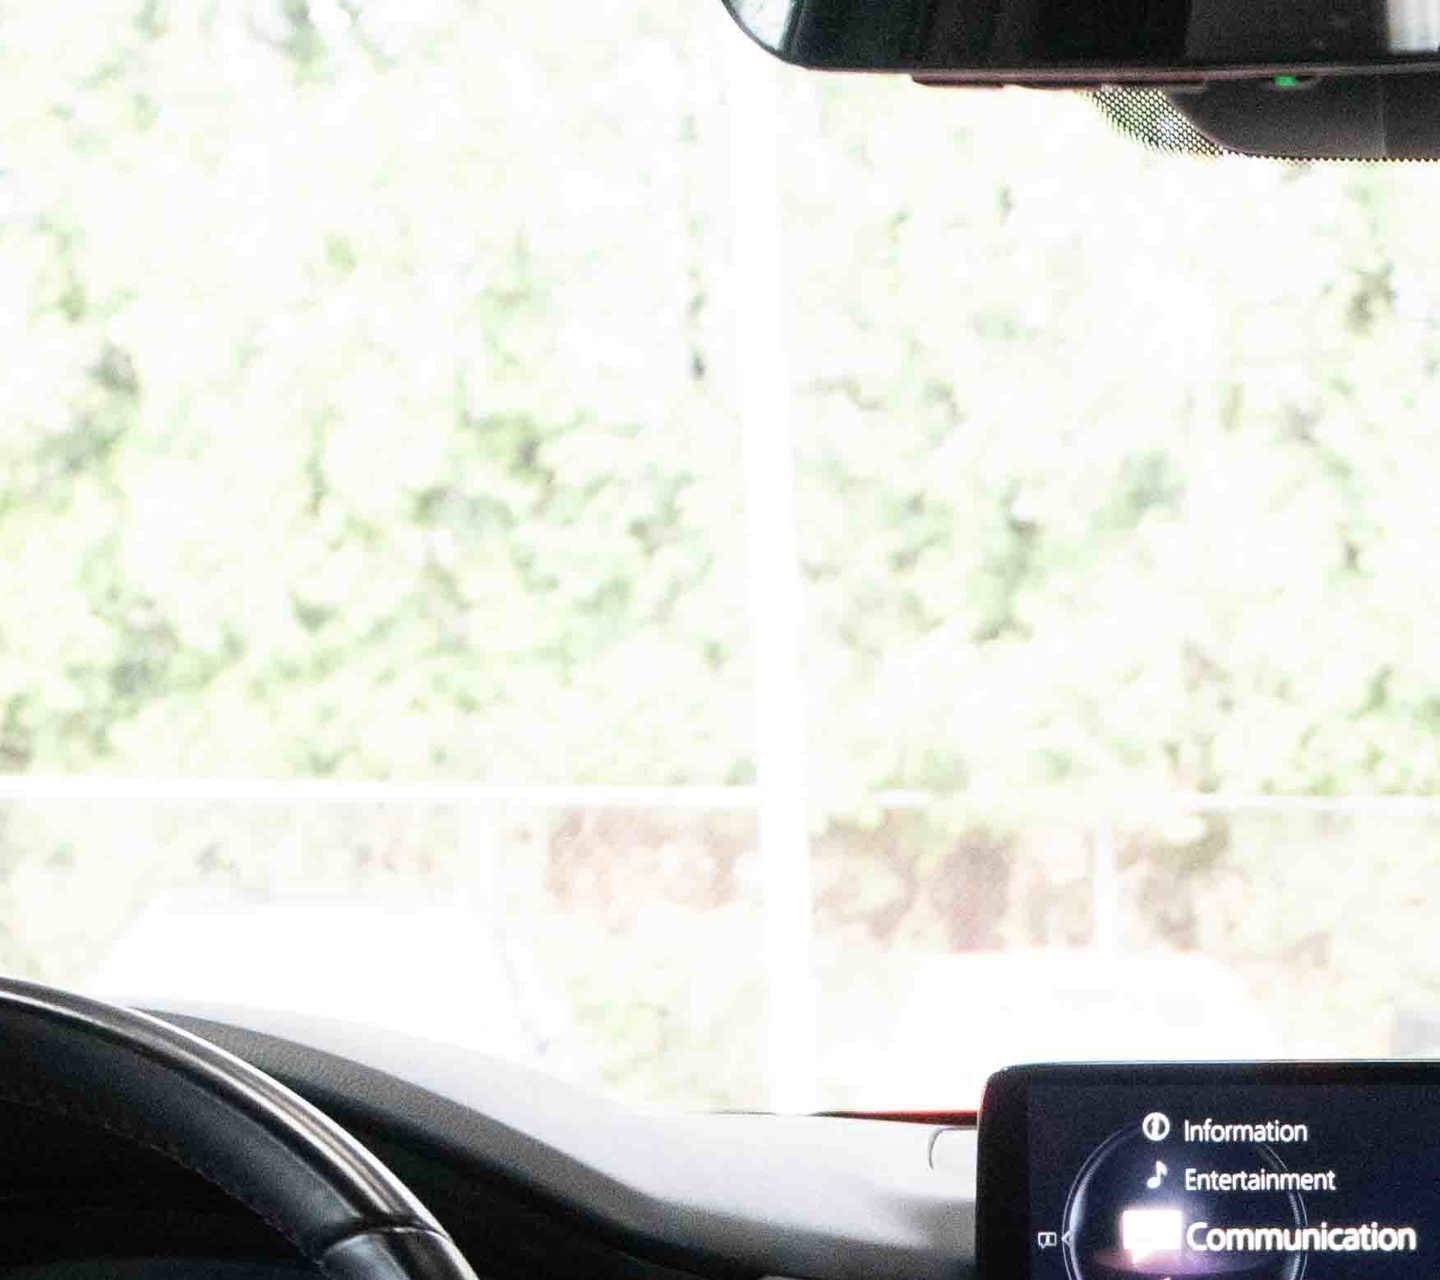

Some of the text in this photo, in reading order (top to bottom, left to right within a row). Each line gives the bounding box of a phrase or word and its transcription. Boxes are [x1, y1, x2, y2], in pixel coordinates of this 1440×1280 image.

[1184, 1118, 1308, 1142] Information
[1185, 1168, 1336, 1191] Entertainment
[1186, 1222, 1417, 1251] Communication
